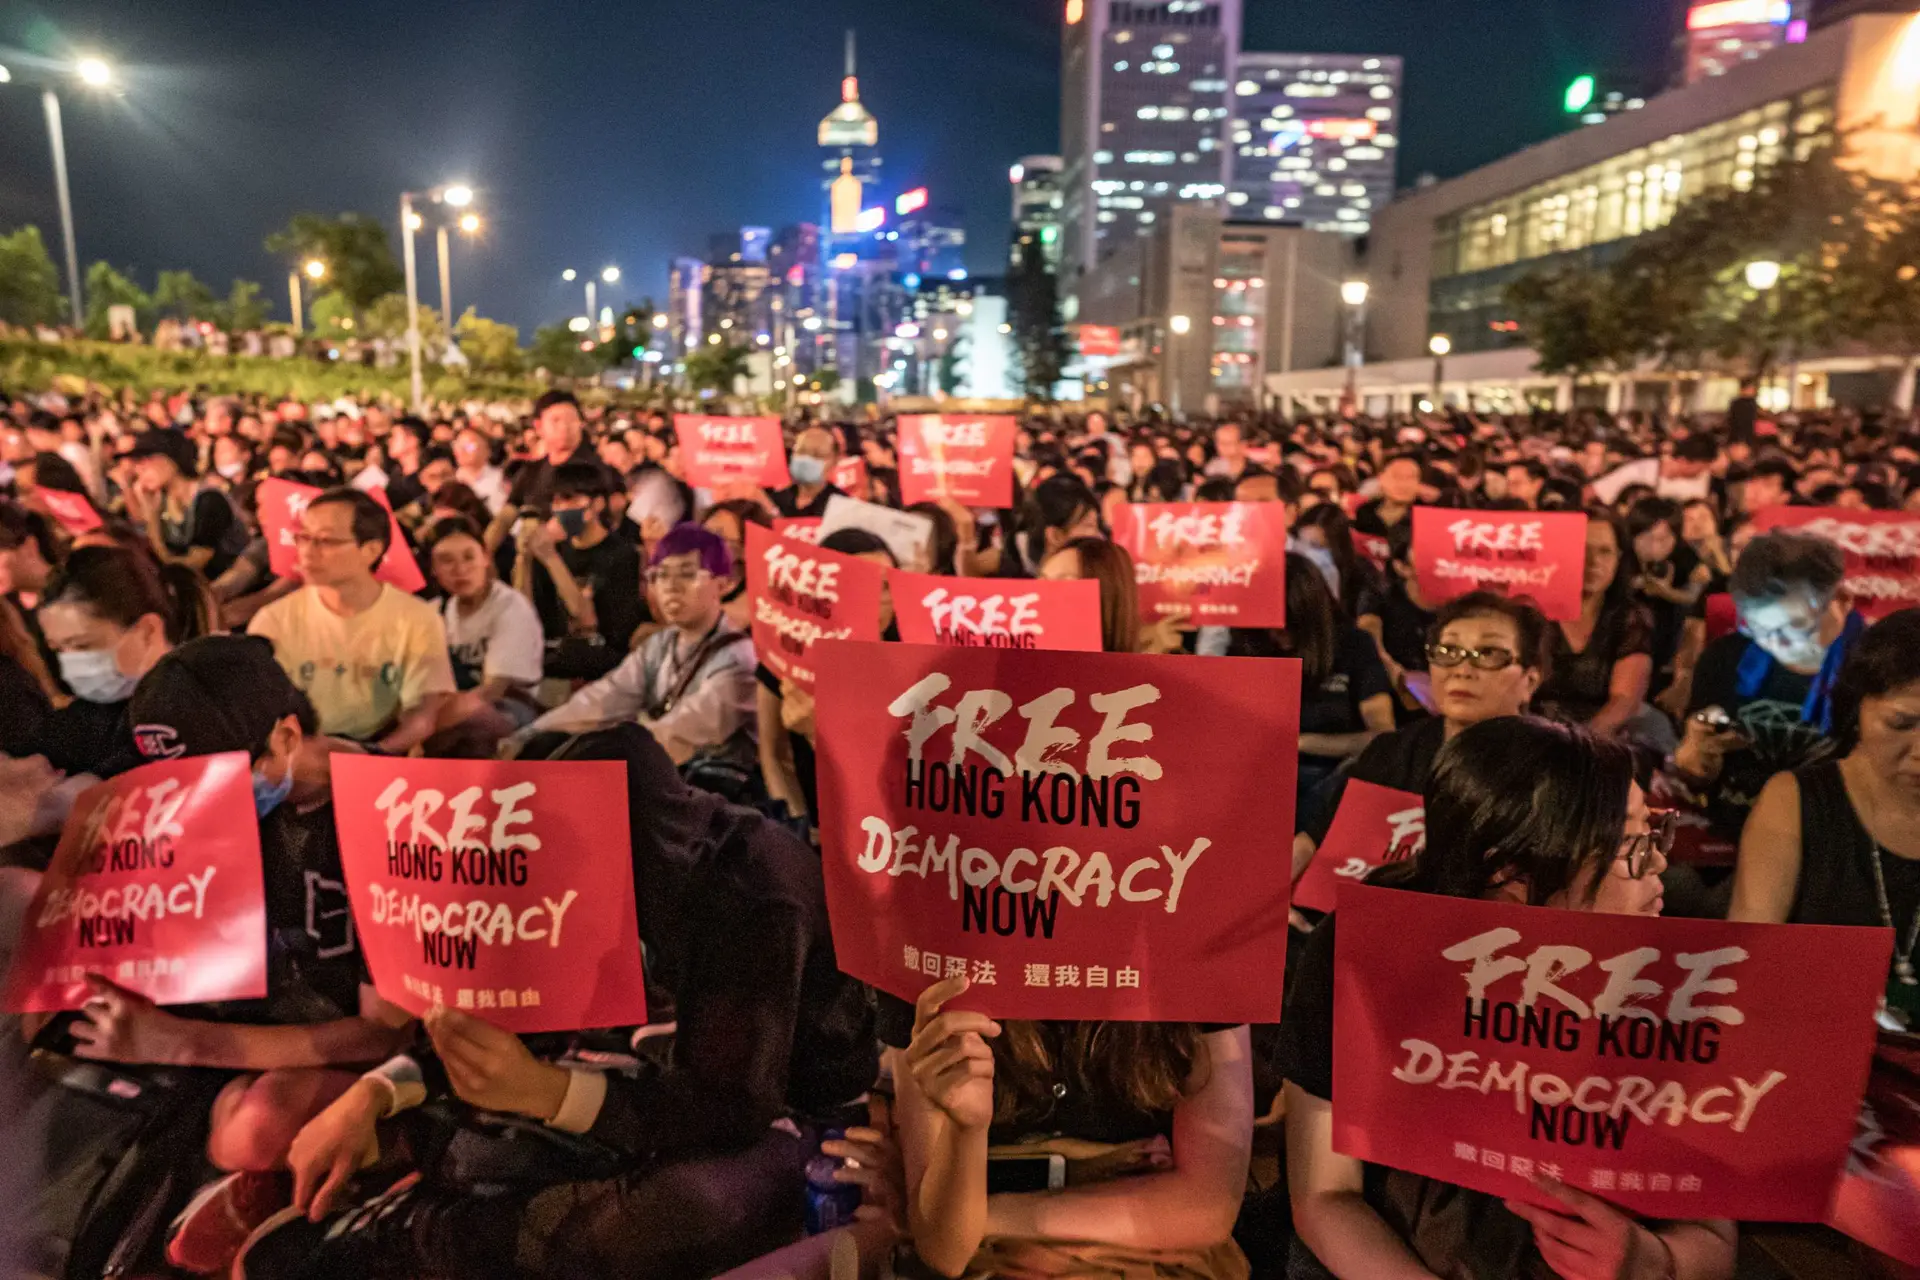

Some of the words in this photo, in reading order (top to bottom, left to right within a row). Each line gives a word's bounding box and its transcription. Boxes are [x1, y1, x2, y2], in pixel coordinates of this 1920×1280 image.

[1447, 518, 1544, 551] FREE
[763, 543, 842, 604] FREE
[921, 588, 1044, 636] FREE
[887, 672, 1164, 785] FREE
[374, 777, 542, 855] FREE
[905, 757, 1005, 819] HONG
[1020, 771, 1142, 830] KONG
[110, 834, 175, 872] KONG
[387, 840, 443, 882] HONG
[452, 846, 528, 887] KONG
[856, 814, 1213, 913] DEMOCRACY
[79, 914, 136, 948] NOW
[368, 882, 579, 948] DEMOCRACY
[961, 884, 1061, 940] NOW
[422, 930, 478, 970] NOW
[1024, 963, 1140, 988] 還我自由
[1441, 926, 1750, 1027] FREE
[1462, 995, 1582, 1053] HONG
[1597, 1011, 1723, 1066] KONG
[1392, 1037, 1788, 1134] DEMOCRACY
[1529, 1103, 1632, 1151] NOW
